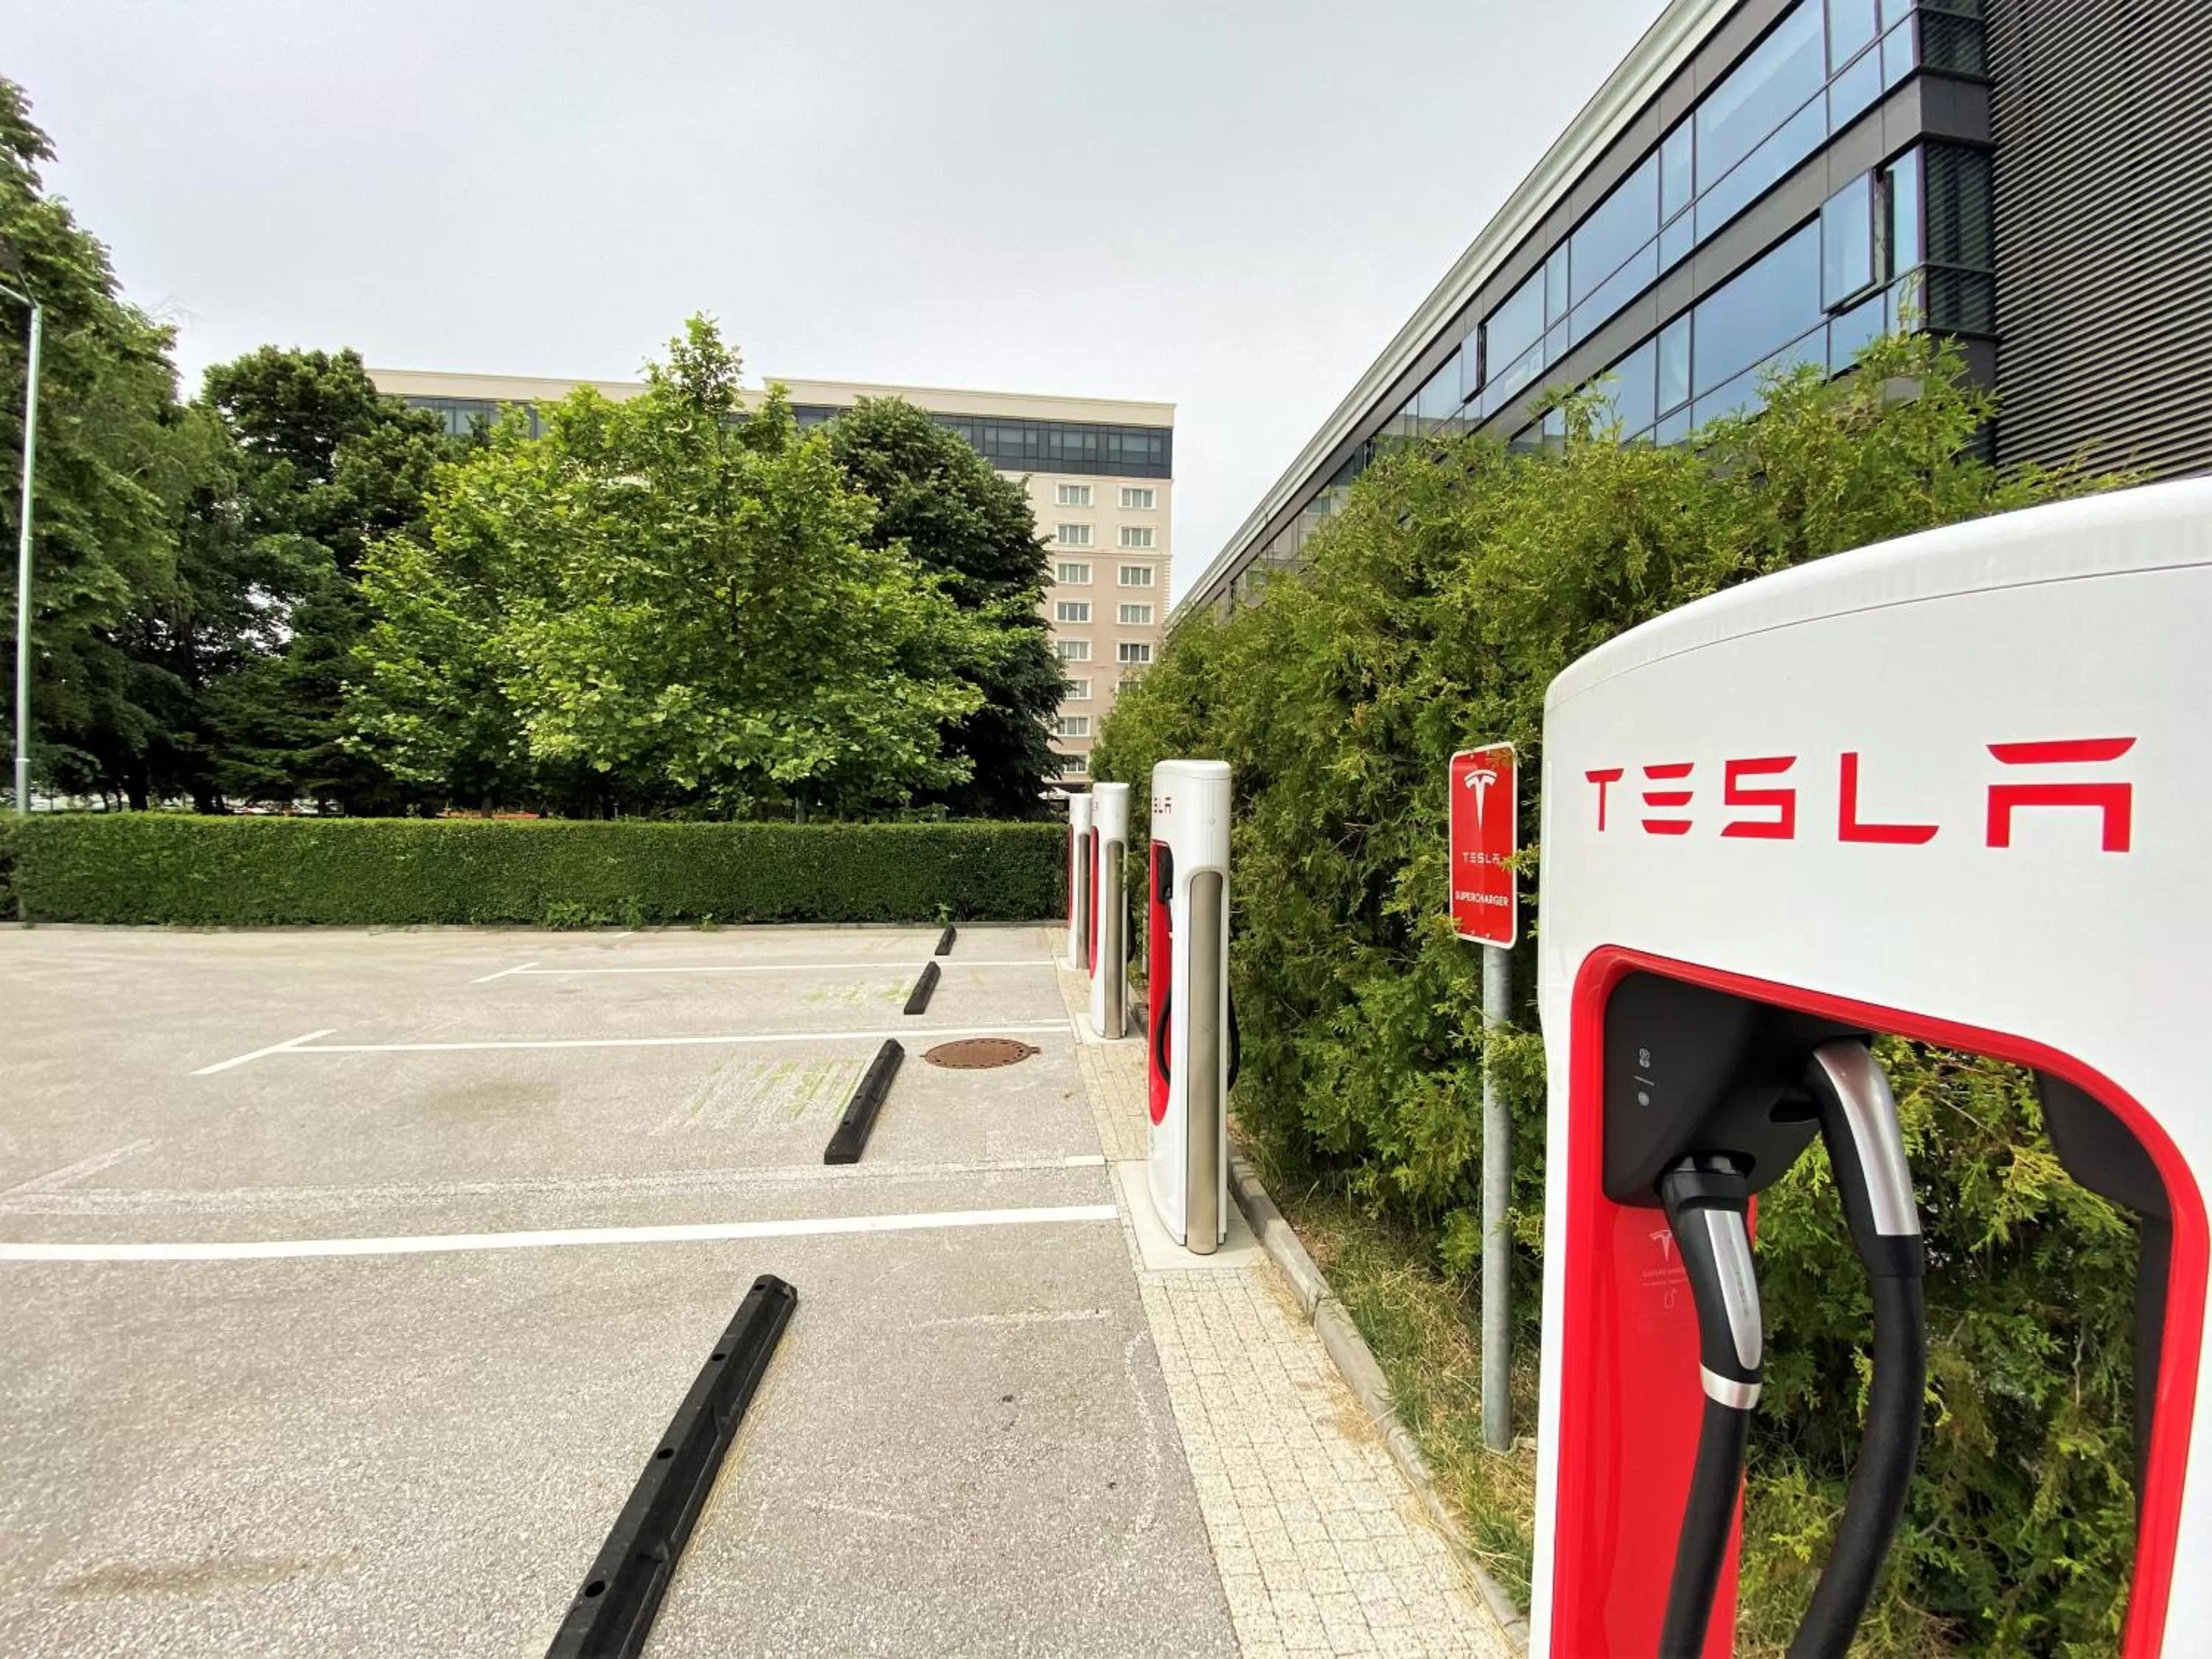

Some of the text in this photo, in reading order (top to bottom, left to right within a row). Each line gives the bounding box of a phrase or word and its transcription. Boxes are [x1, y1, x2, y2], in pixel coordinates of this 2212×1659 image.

[1585, 737, 2137, 853] TESLA
[1462, 852, 1500, 865] TESLA
[1455, 890, 1509, 907] SUPERCHARGER
